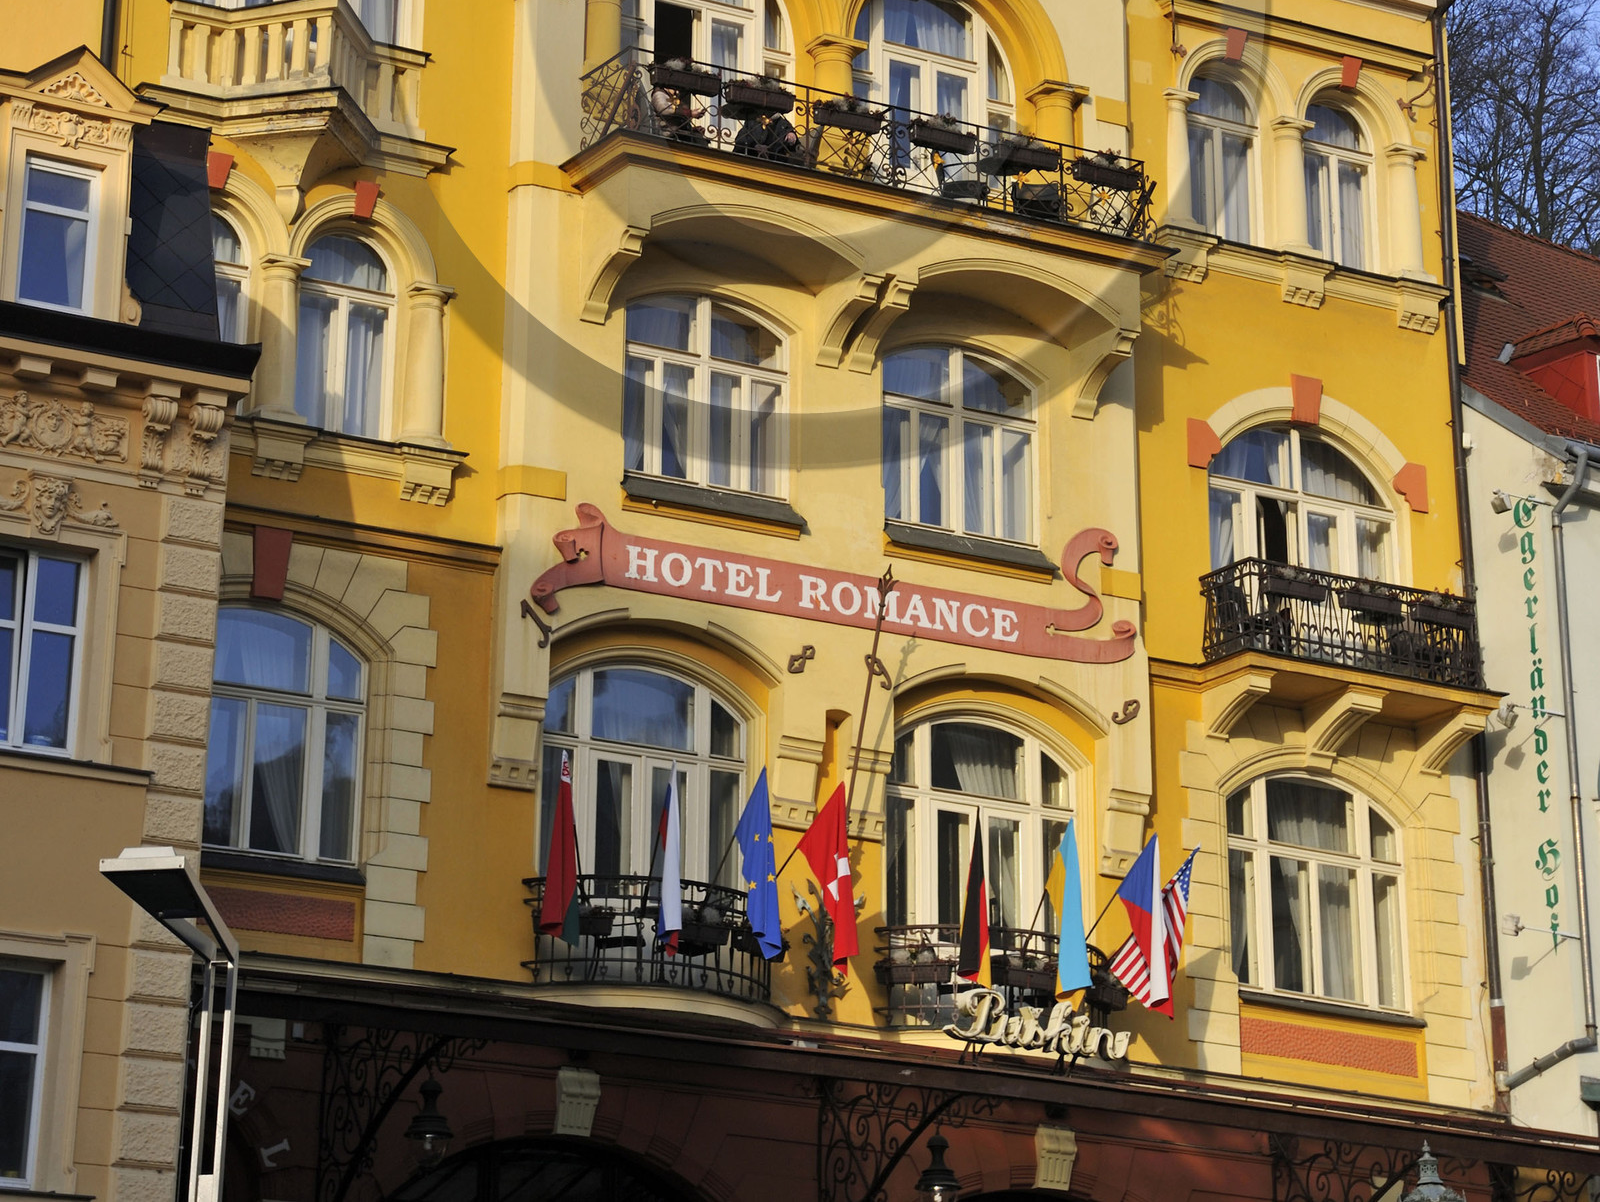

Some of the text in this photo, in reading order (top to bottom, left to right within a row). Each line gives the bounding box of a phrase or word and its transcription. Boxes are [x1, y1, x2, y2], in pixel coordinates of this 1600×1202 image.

[625, 545, 1020, 643] HOTEL ROMANCE
[1513, 495, 1560, 956] Egerländer Hof
